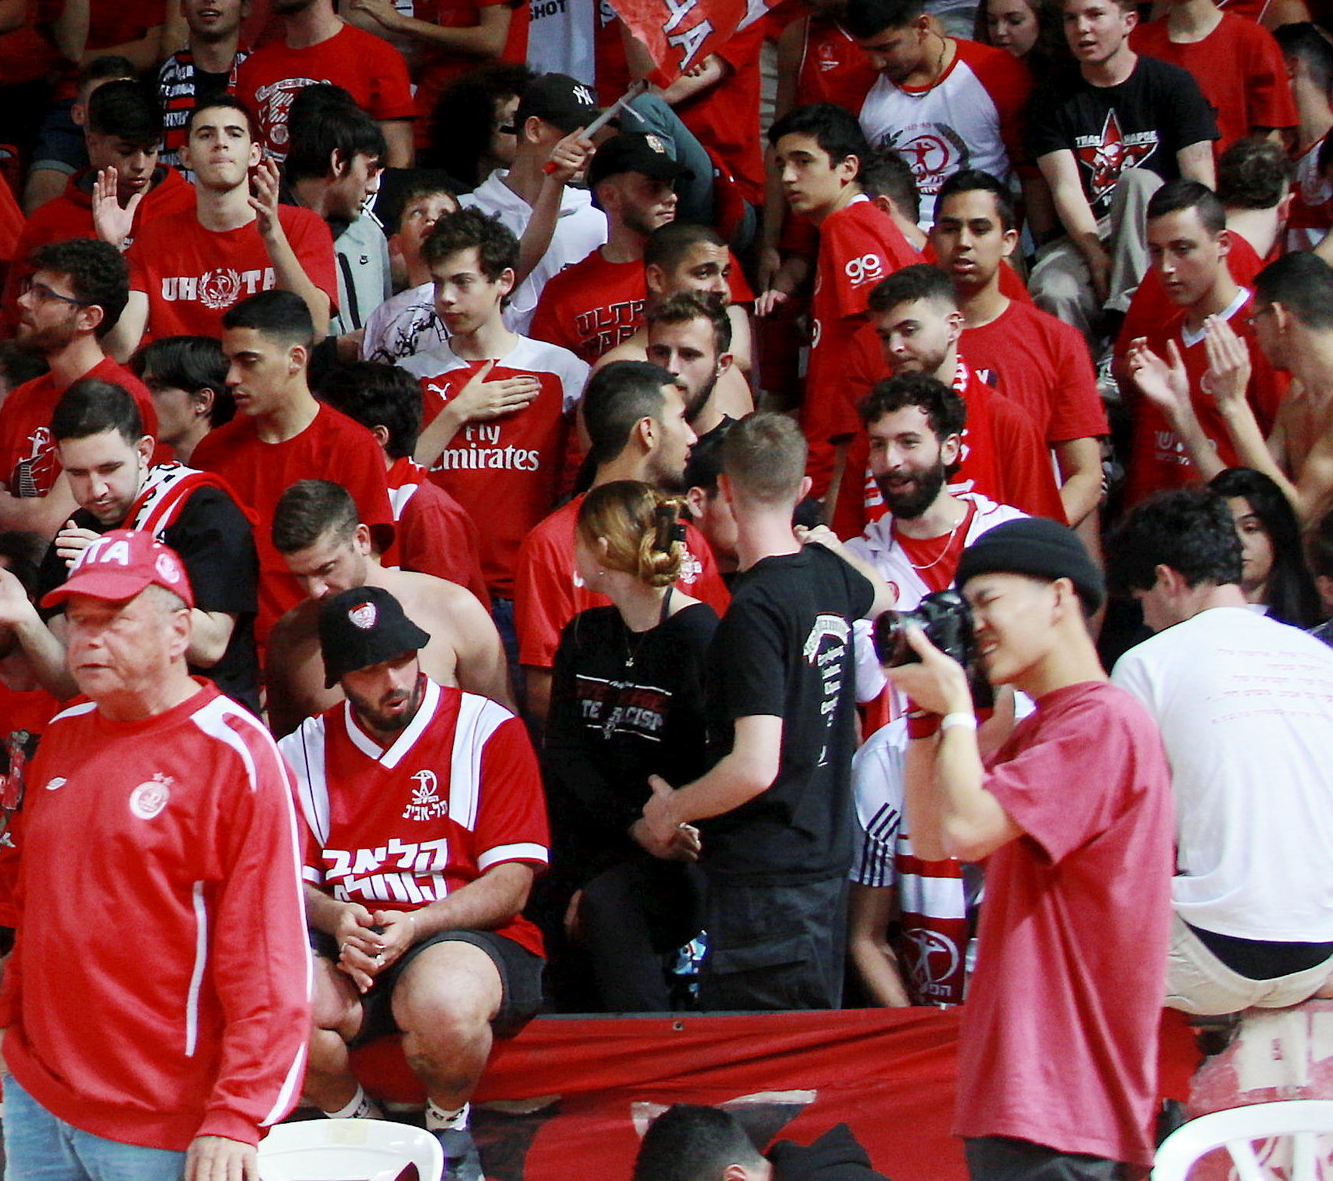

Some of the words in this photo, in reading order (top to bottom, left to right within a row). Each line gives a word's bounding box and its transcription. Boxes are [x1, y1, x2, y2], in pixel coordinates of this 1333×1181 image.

[529, 0, 566, 21] HOT
[157, 277, 198, 303] UH
[426, 446, 541, 475] mirates
[320, 837, 450, 882] קלאב
